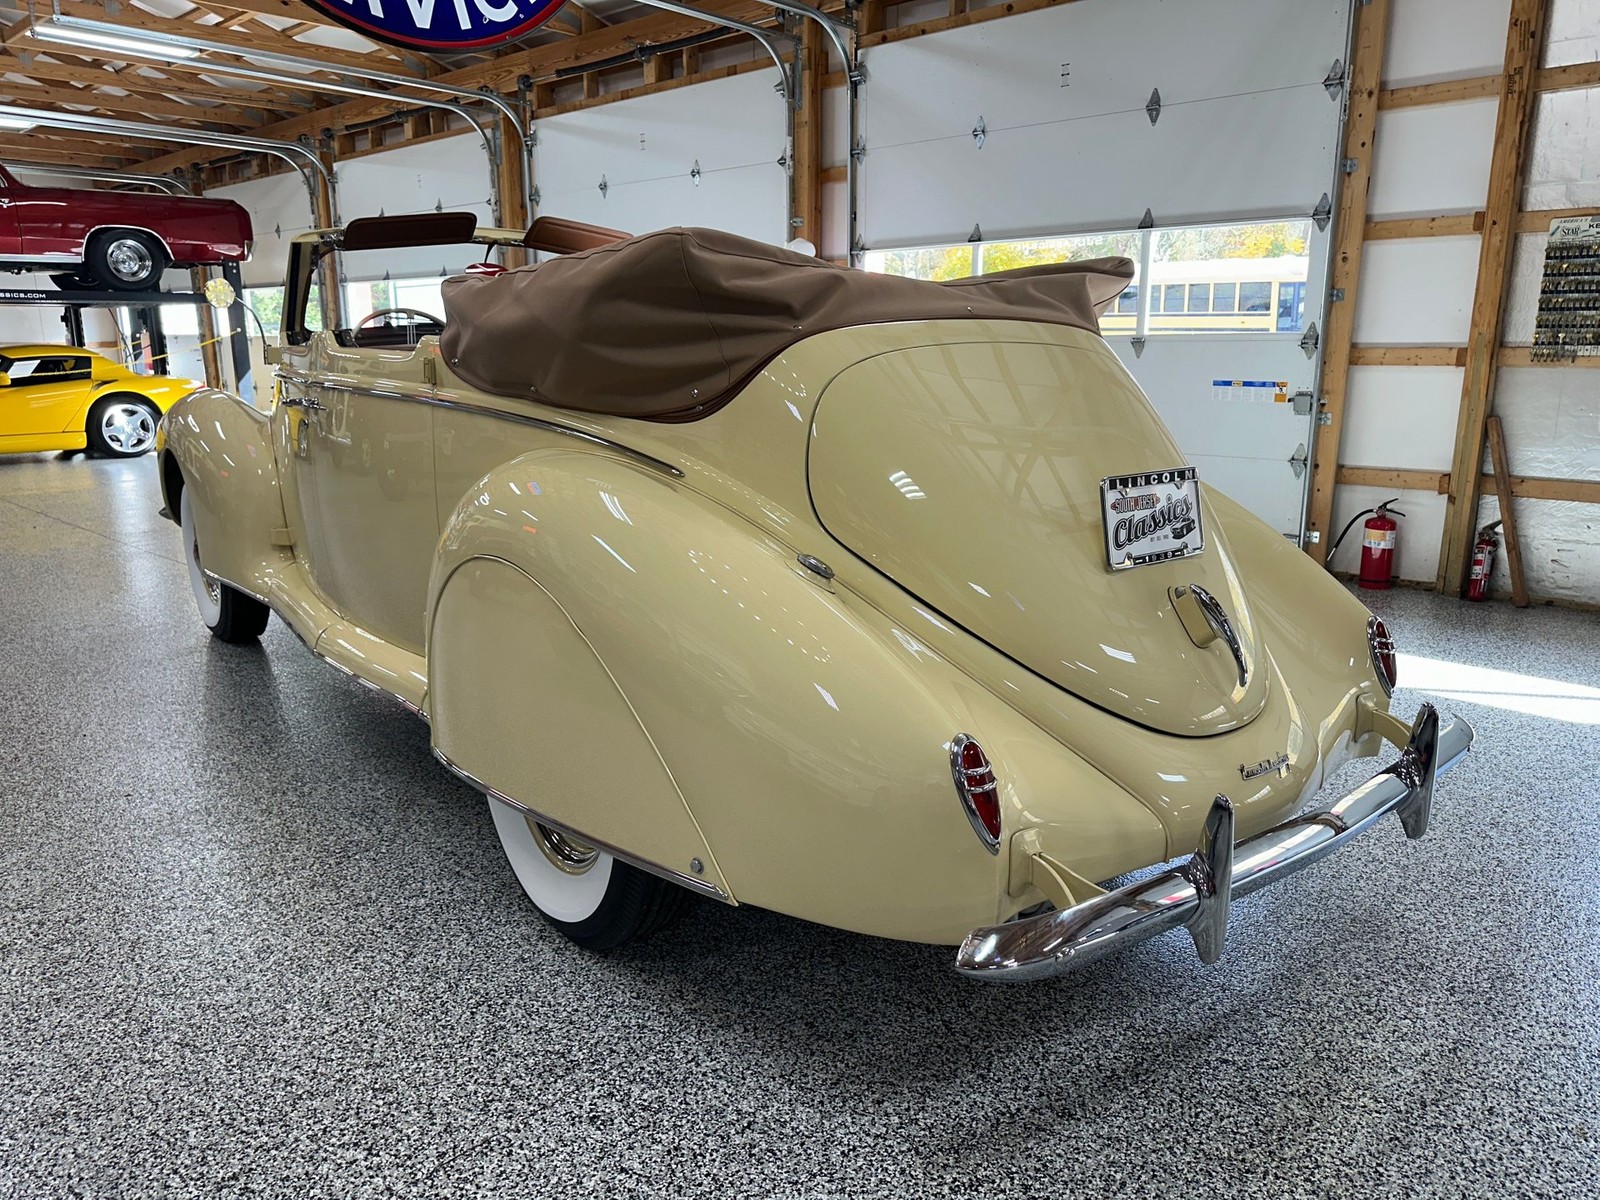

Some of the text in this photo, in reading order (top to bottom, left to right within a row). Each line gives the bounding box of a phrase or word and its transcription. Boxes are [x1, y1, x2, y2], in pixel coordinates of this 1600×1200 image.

[1562, 227, 1580, 236] STAR
[1116, 469, 1193, 489] LINCOLN
[1115, 493, 1158, 514] SOUTH JERSEY
[1113, 493, 1193, 551] Classics
